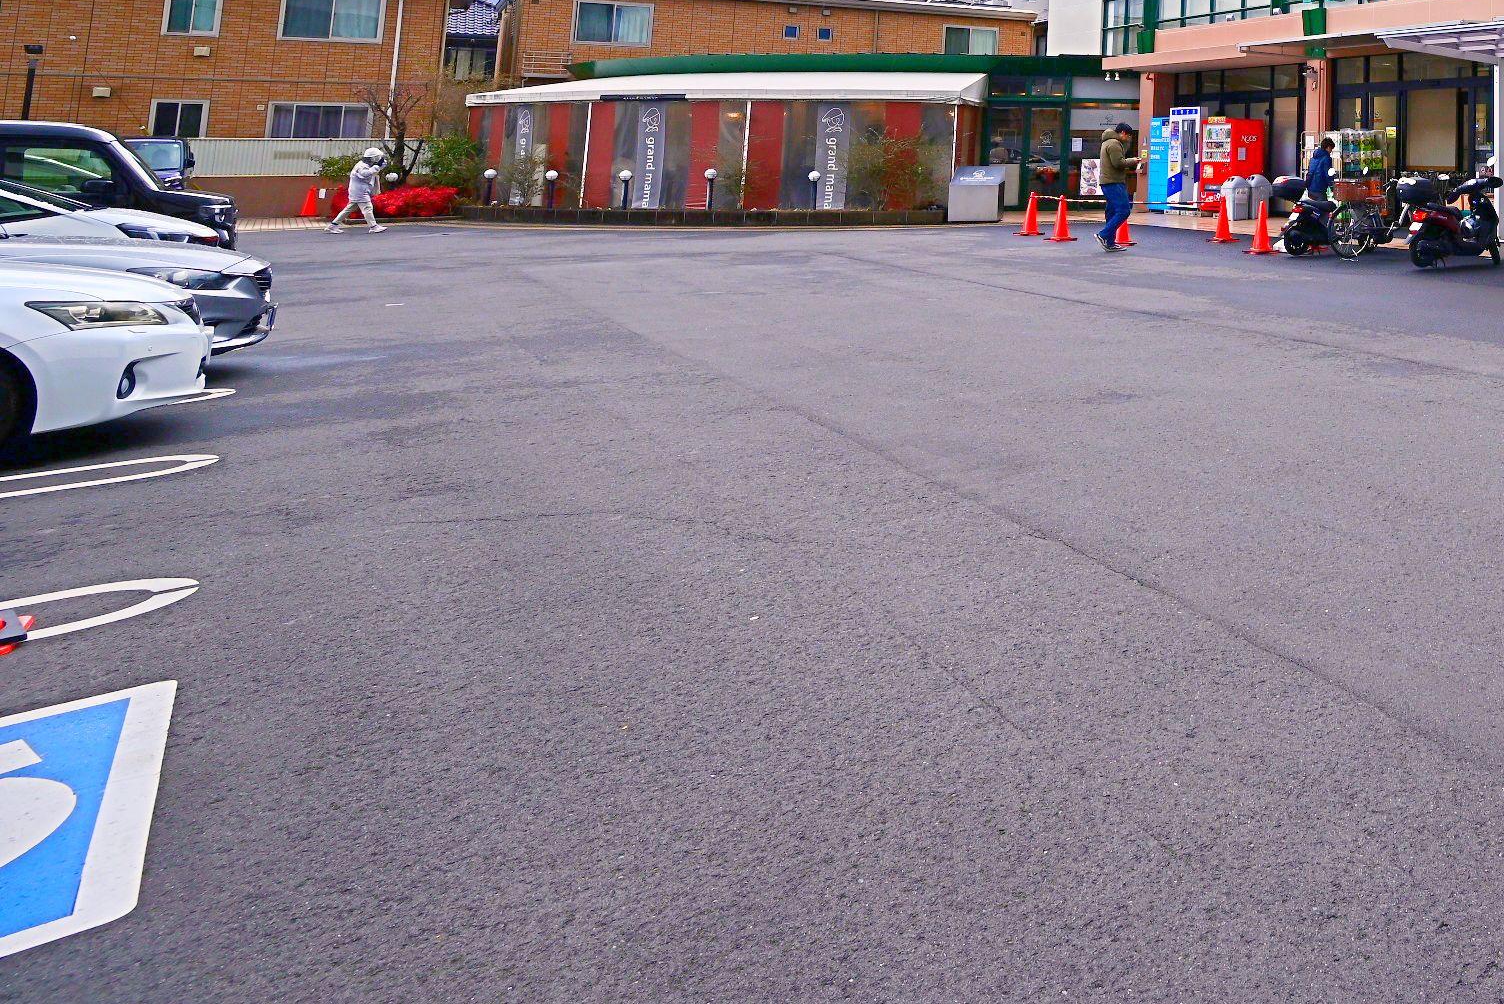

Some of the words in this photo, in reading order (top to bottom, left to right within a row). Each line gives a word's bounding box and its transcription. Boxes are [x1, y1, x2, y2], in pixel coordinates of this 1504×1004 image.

[645, 137, 656, 170] grand
[825, 137, 838, 171] grand
[641, 173, 655, 208] mama
[823, 174, 836, 209] mama
